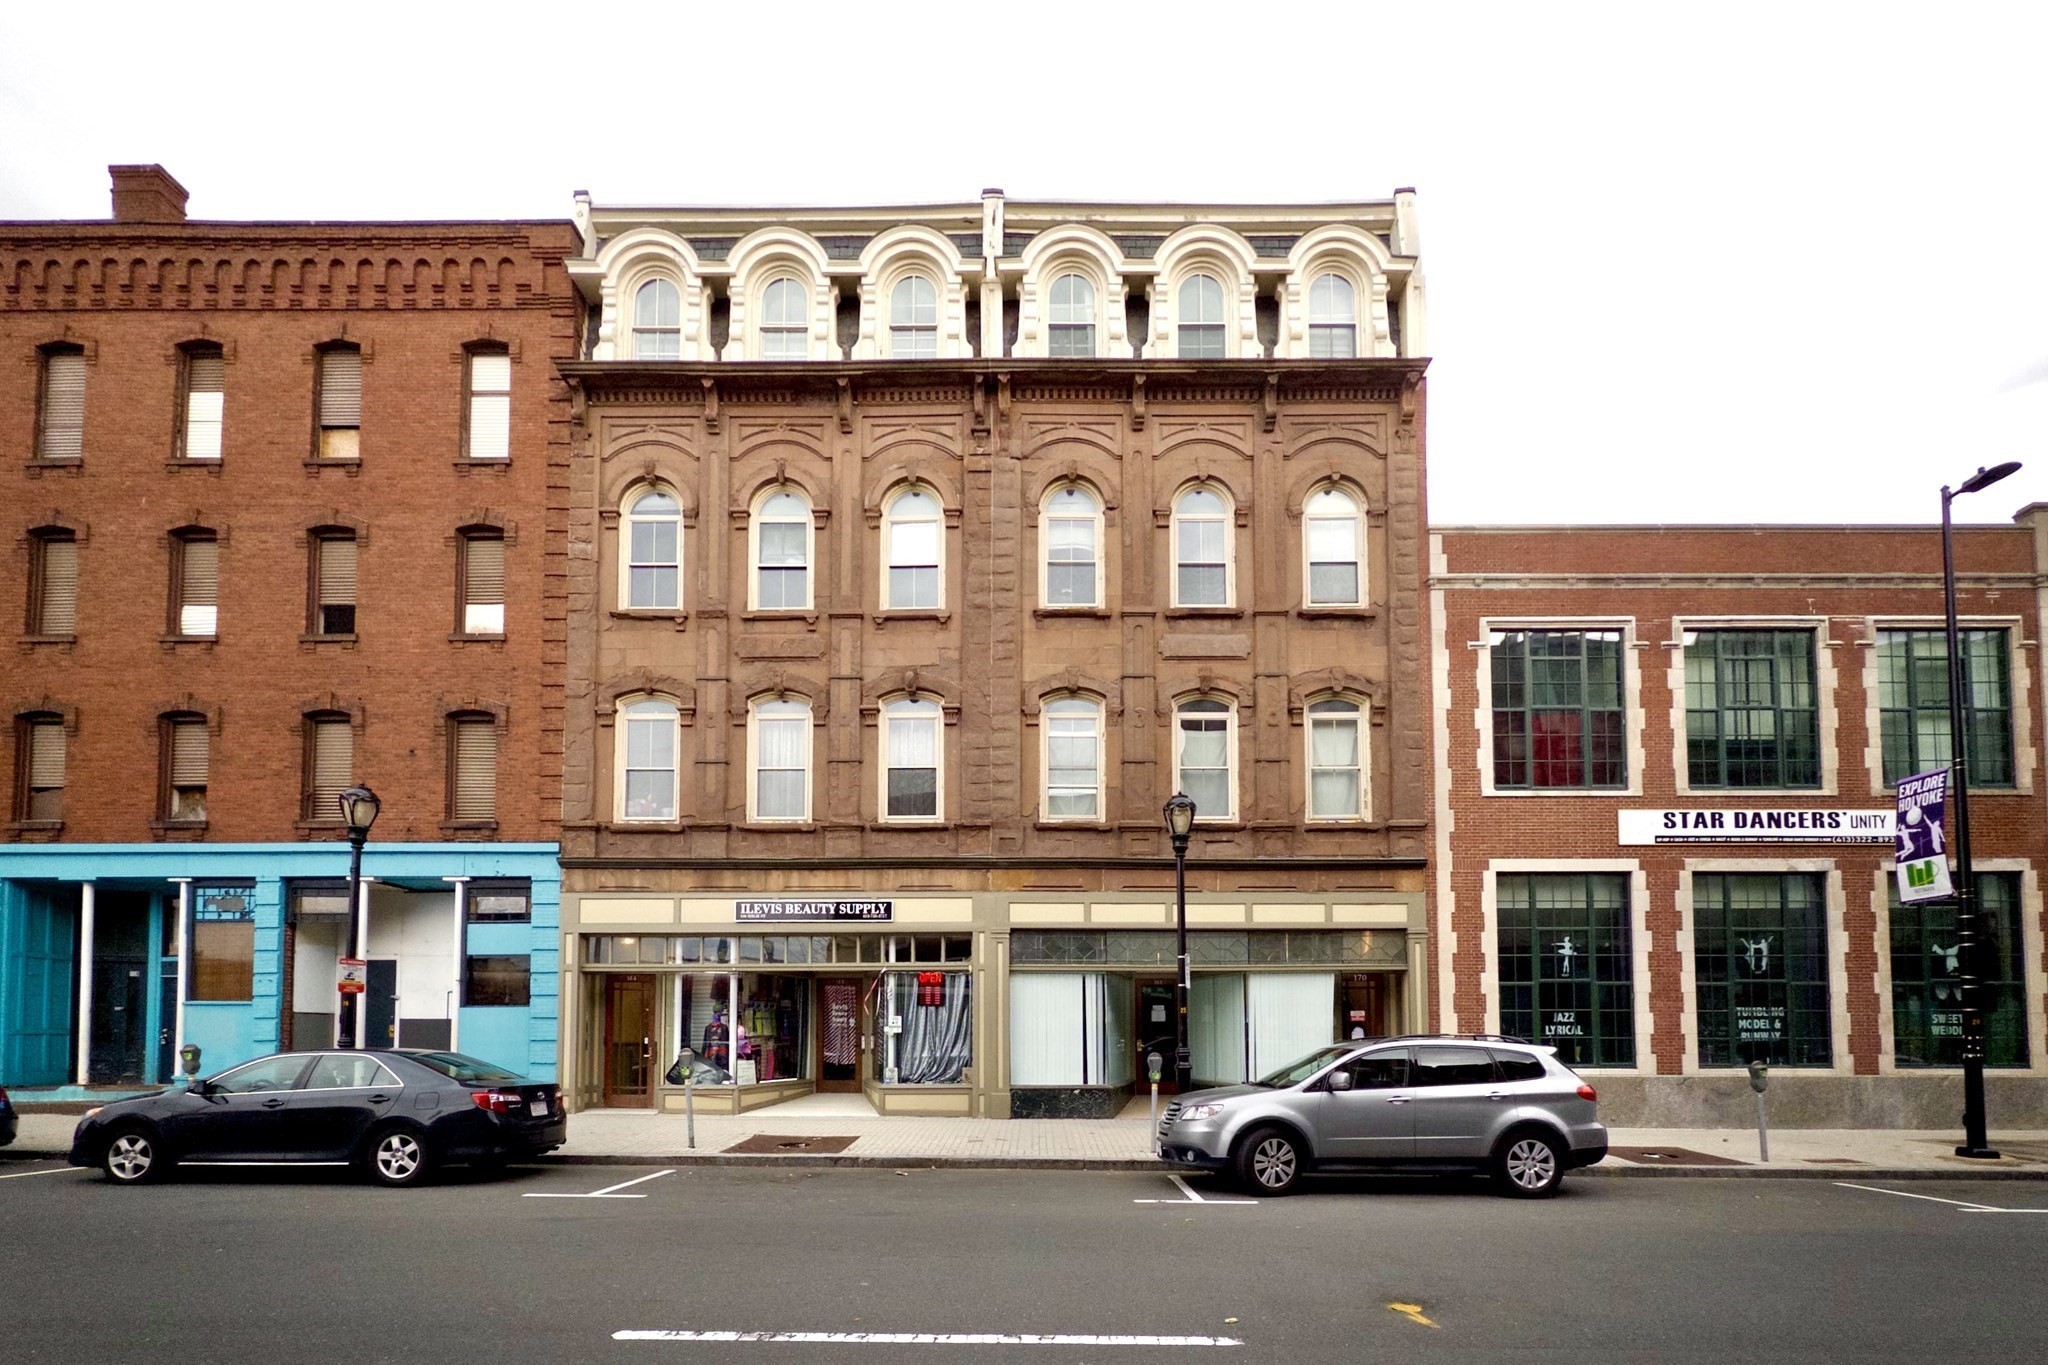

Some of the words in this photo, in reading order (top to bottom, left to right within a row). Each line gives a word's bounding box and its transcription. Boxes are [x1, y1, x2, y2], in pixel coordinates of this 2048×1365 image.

[1899, 774, 1945, 798] EXPLORE
[1898, 788, 1943, 813] HOLYOKE
[1663, 811, 1724, 829] STAR
[1850, 814, 1886, 829] UNITY
[1832, 835, 1895, 843] (413)322-893
[740, 903, 783, 914] ILEVIS
[785, 903, 837, 914] BEAUTY
[839, 903, 887, 914] SUPPLY
[918, 972, 942, 983] OPEN
[1553, 1012, 1575, 1022] JAZZ
[1736, 1006, 1785, 1017] TUMBLNG
[1738, 1019, 1770, 1029] MODEL
[1774, 1019, 1781, 1029] &
[1545, 1025, 1584, 1035] LYRICAL
[1931, 1025, 1963, 1036] WEDDI
